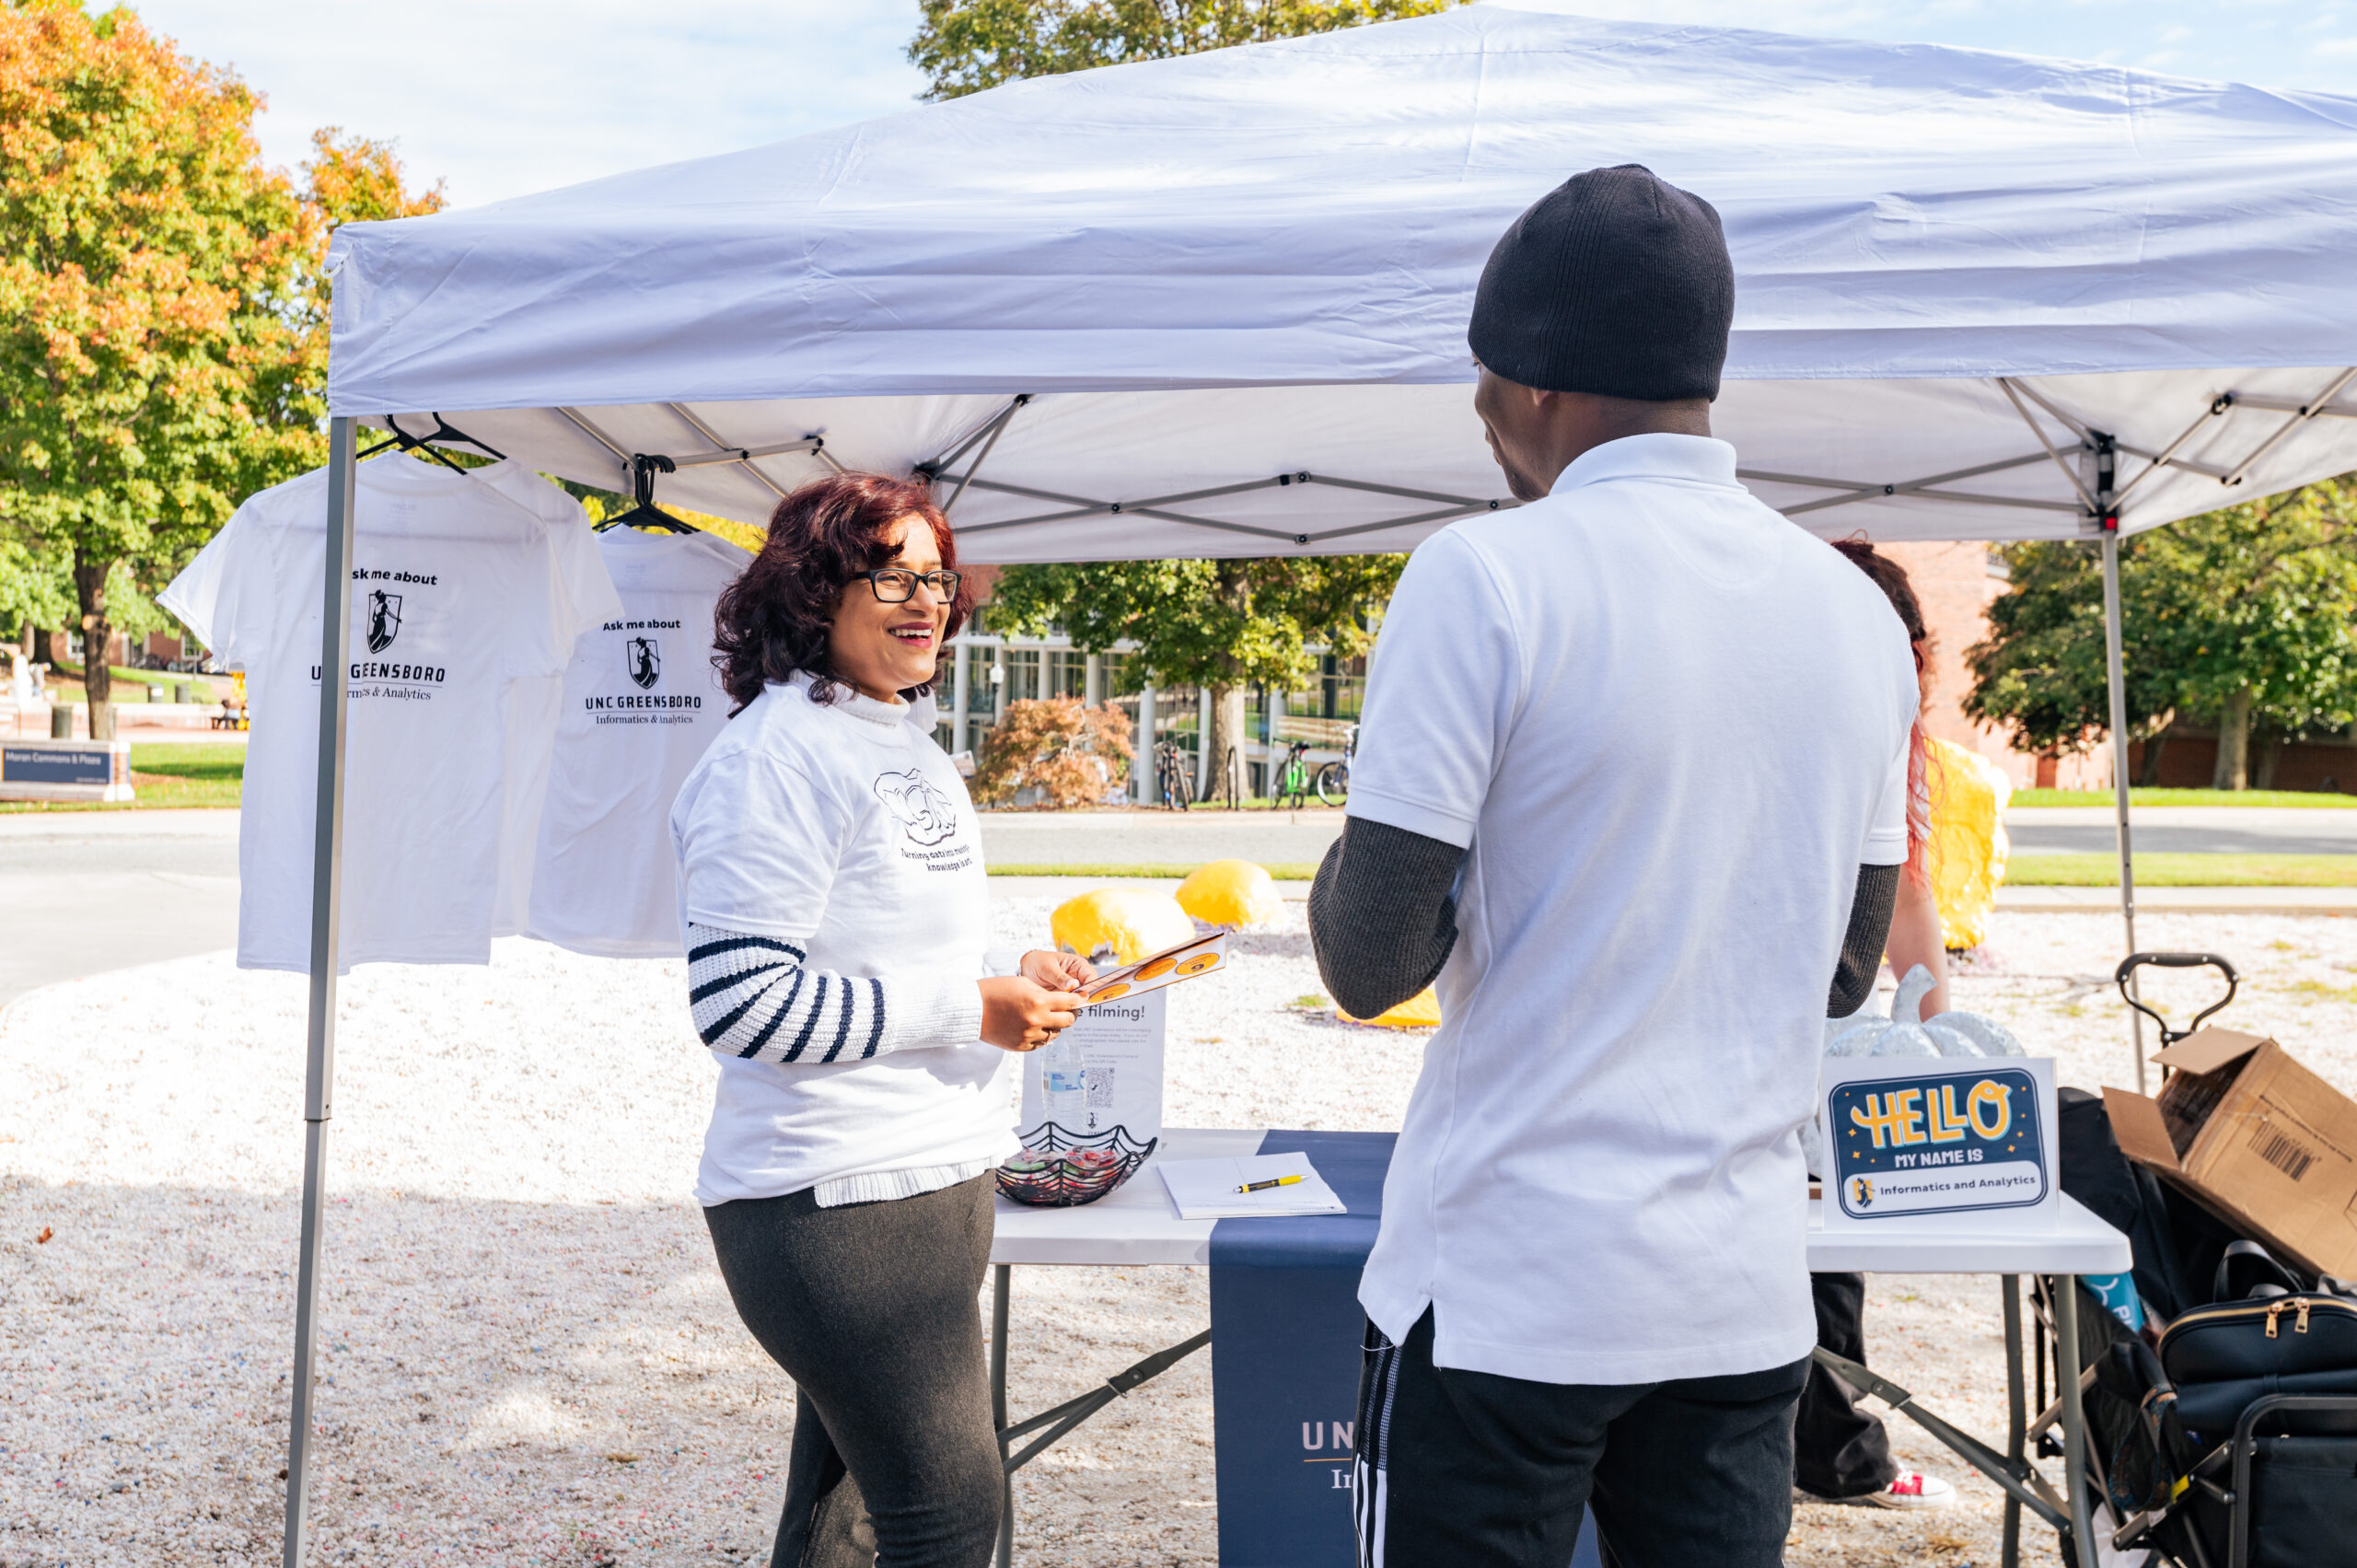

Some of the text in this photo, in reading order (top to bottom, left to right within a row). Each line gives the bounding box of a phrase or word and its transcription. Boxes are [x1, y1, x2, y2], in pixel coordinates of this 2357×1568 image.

[352, 568, 438, 586] sk me about
[603, 619, 681, 632] Ask me about
[382, 687, 432, 701] Analytics
[586, 695, 702, 710] UNC GREENSBORO
[596, 714, 649, 725] Informatics
[650, 714, 657, 724] &
[32, 752, 71, 764] Commons
[901, 848, 930, 860] Turning
[926, 862, 960, 871] knowledge
[1088, 1005, 1145, 1021] filming!
[1851, 1079, 2013, 1149] HELLO
[1895, 1148, 1984, 1168] MY NAME IS
[1880, 1176, 2036, 1195] Informatics and Analytics
[1302, 1421, 1354, 1450] UN
